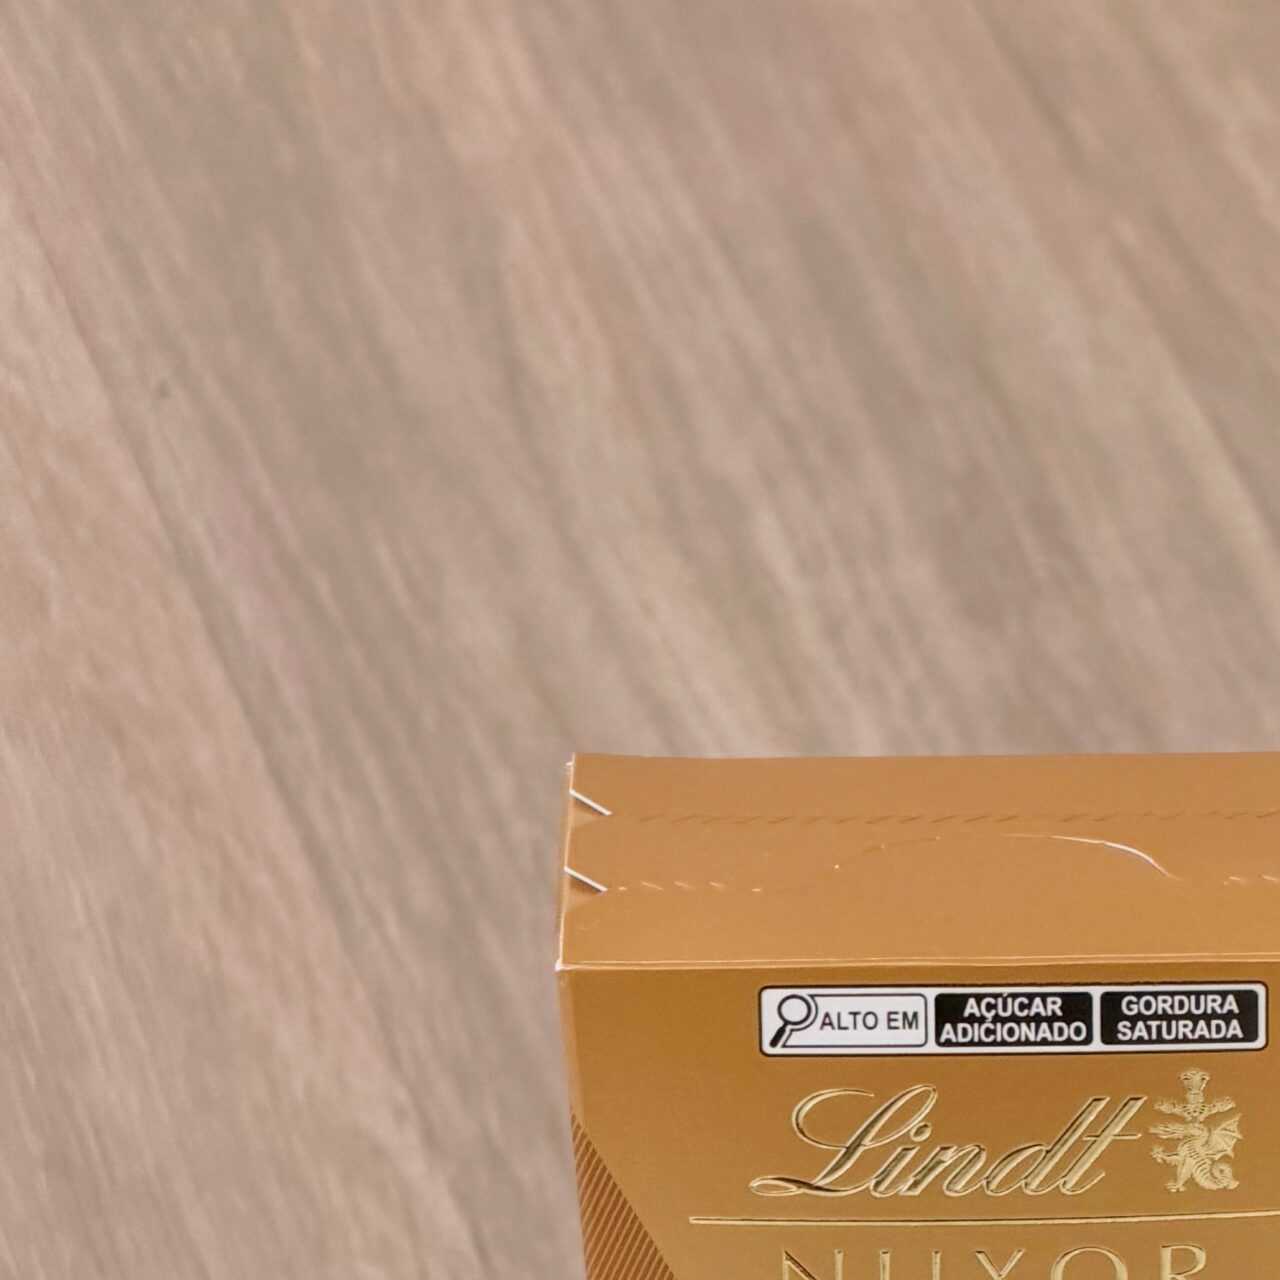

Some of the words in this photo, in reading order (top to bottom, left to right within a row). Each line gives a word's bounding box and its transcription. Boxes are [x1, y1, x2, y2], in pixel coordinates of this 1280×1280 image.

[963, 993, 1063, 1024] AÇÚCAR
[1120, 994, 1240, 1017] GORDURA
[819, 1010, 878, 1031] ALTO
[886, 1010, 920, 1031] EM
[1116, 1018, 1244, 1042] SATURADA
[940, 1021, 1087, 1044] ADICIONADO
[749, 1083, 1148, 1198] Lindt
